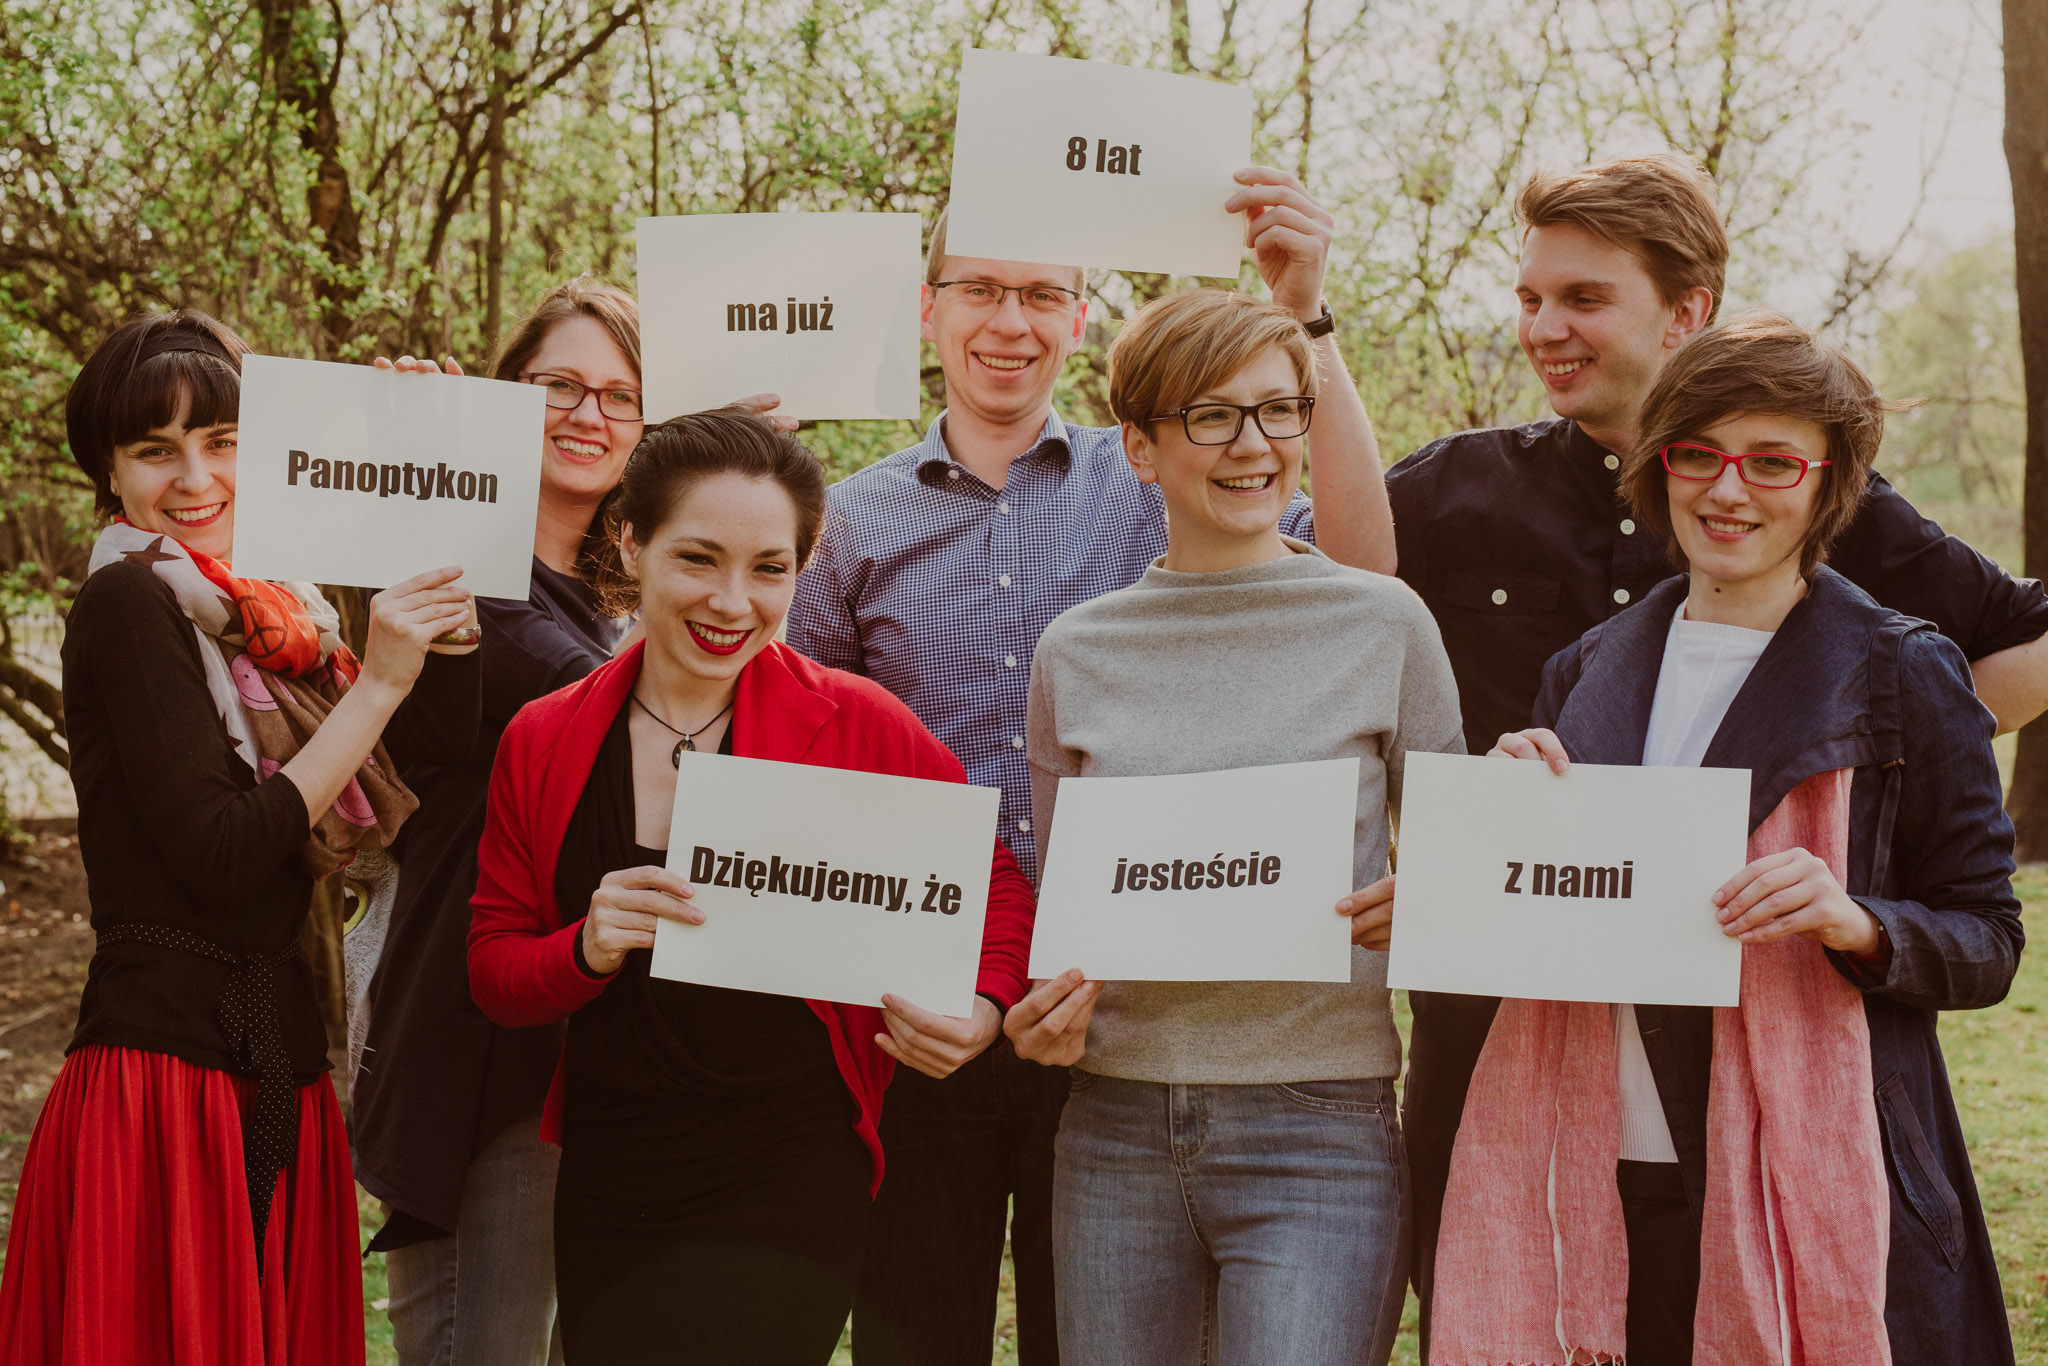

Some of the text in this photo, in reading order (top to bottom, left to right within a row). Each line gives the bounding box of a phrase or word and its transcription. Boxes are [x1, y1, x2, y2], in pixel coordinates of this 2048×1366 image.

[1066, 136, 1143, 176] 8 lat
[727, 296, 834, 335] ma już
[287, 449, 498, 504] Panoptykon
[689, 845, 962, 916] Dziękujemy, że
[1111, 851, 1281, 894] jesteście
[1504, 860, 1634, 899] z nami
